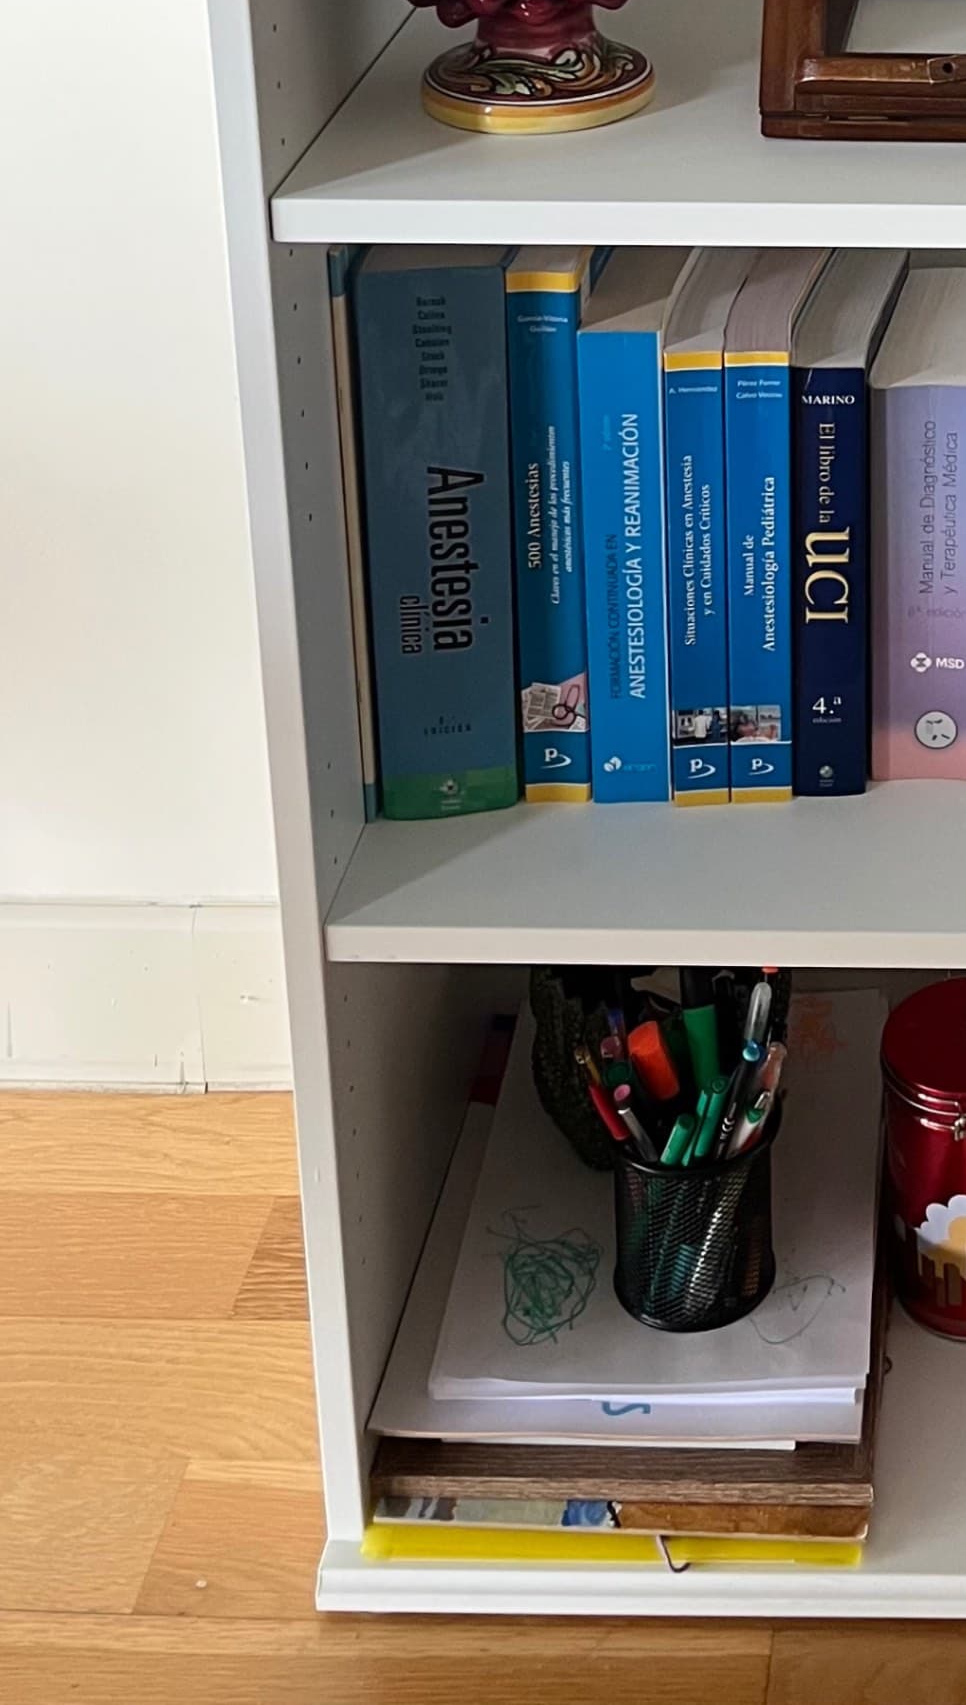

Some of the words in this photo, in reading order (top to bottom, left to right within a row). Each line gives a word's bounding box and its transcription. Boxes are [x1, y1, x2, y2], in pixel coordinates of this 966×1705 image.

[801, 394, 856, 405] MARINO
[819, 423, 835, 439] El
[619, 414, 641, 536] REANIMACIÓN
[681, 455, 693, 510] Anestesia
[819, 445, 835, 482] libro
[919, 420, 938, 509] Diagnóstico
[942, 432, 958, 488] Médica
[525, 462, 541, 537] Anestesias
[699, 484, 711, 530] Críticos
[761, 476, 775, 547] Pediátrica
[819, 485, 835, 505] de
[819, 510, 835, 524] la
[605, 534, 618, 549] EN
[684, 513, 694, 528] en
[742, 534, 755, 550] de
[920, 514, 935, 534] de
[940, 494, 959, 580] Terapéutica
[427, 466, 488, 651] Anestesia
[527, 543, 541, 569] 500
[625, 542, 642, 553] Y
[683, 530, 695, 578] Clínicas
[699, 533, 712, 588] Cuidados
[919, 539, 935, 594] Manual
[742, 552, 755, 596] Manual
[944, 585, 958, 595] y
[684, 580, 696, 645] Situaciones
[703, 592, 712, 606] en
[704, 606, 715, 616] y
[761, 551, 779, 651] Anestesiología
[401, 596, 429, 654] clínica
[622, 559, 645, 699] ANESTESIOLOGÍA
[935, 657, 965, 670] MSD
